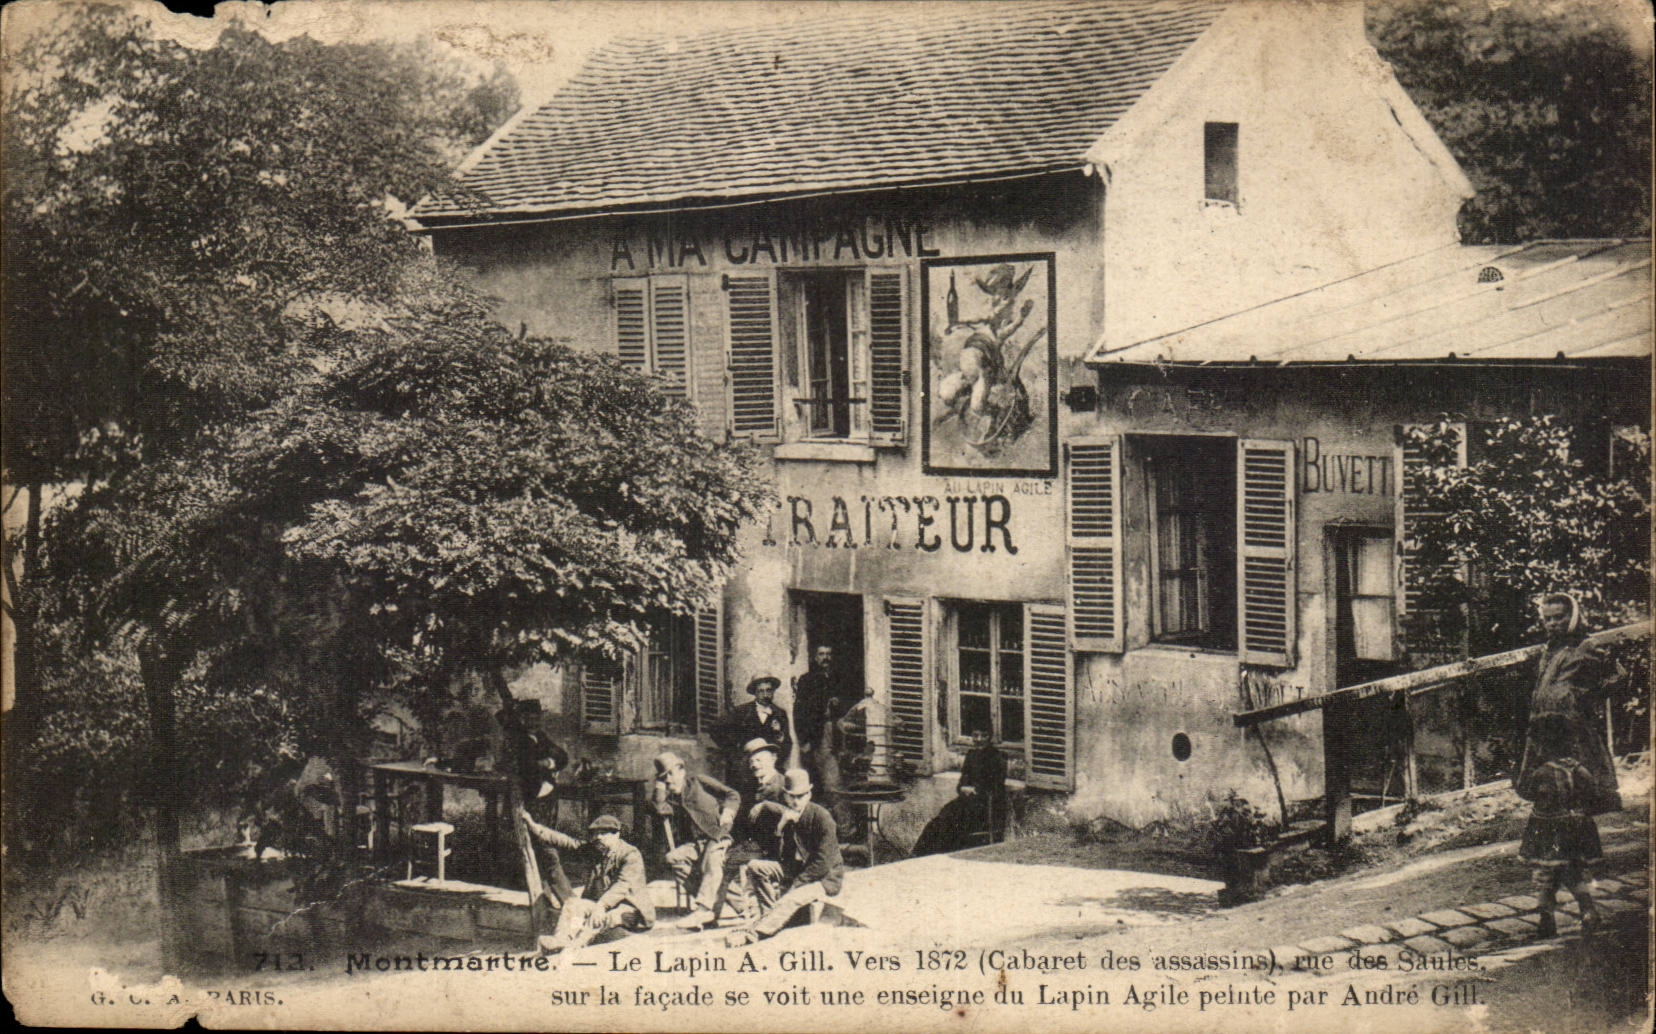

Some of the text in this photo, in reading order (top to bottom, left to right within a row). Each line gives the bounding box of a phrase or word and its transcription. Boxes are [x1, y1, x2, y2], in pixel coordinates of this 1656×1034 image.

[611, 217, 941, 270] A MA CAMPAGNE
[944, 480, 1053, 496] AU LAPIN AGILE
[761, 494, 1018, 555] TRAITEUR
